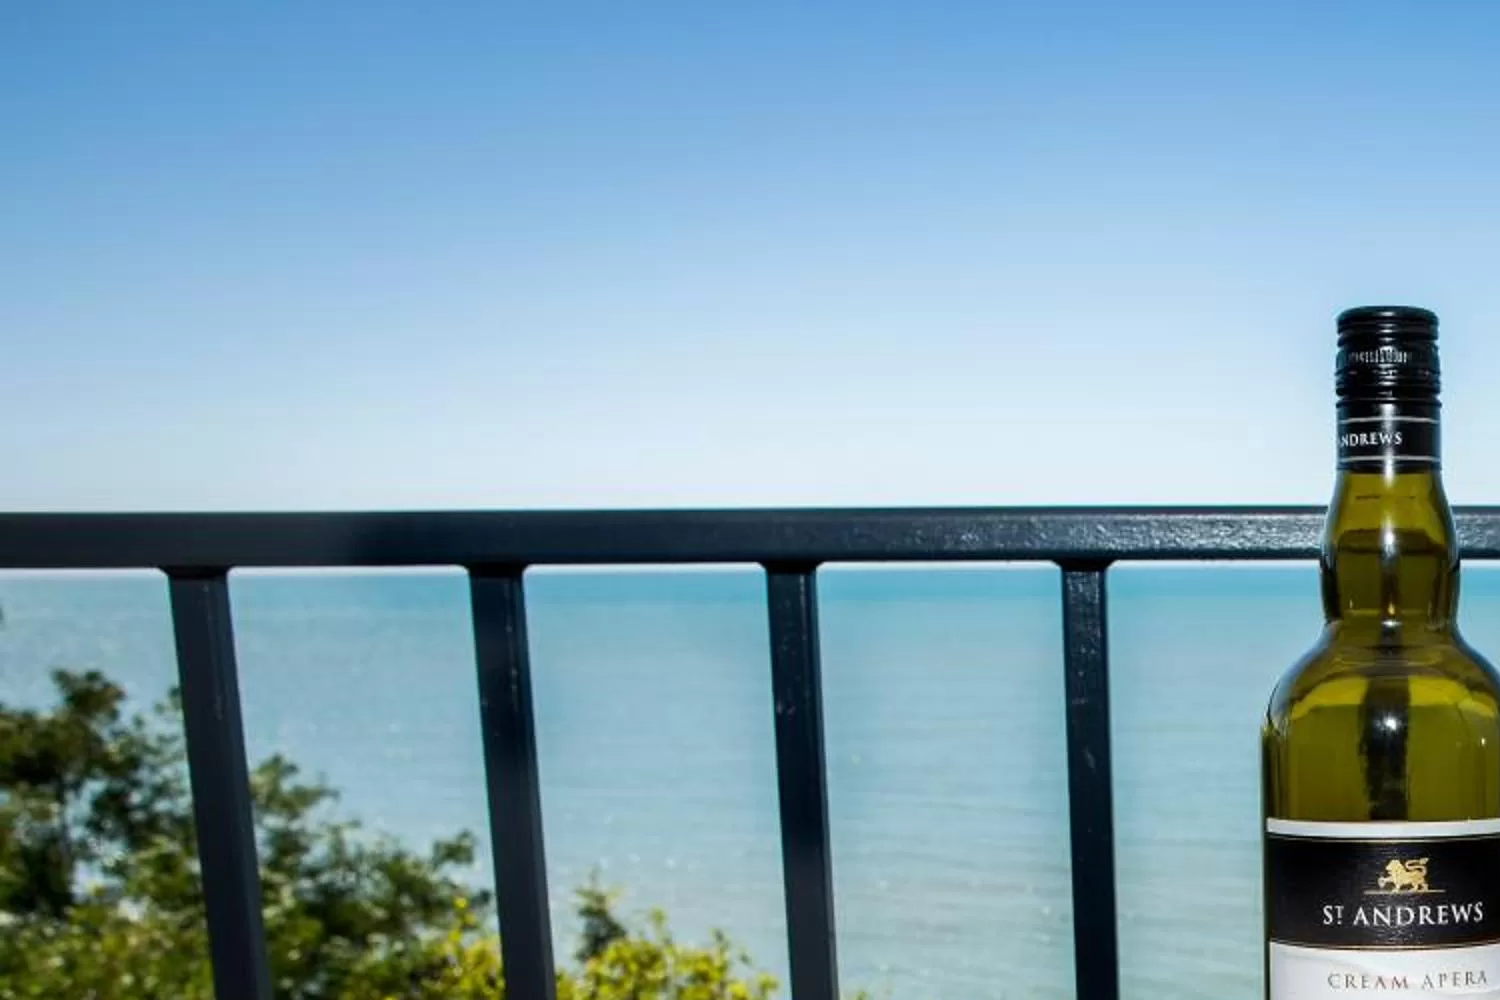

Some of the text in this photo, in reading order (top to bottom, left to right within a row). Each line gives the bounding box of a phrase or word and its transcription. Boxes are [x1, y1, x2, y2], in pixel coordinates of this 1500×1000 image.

[1338, 432, 1403, 448] NDREWS
[1353, 902, 1484, 926] ANDREWS
[1327, 970, 1488, 990] CREAM APERA
